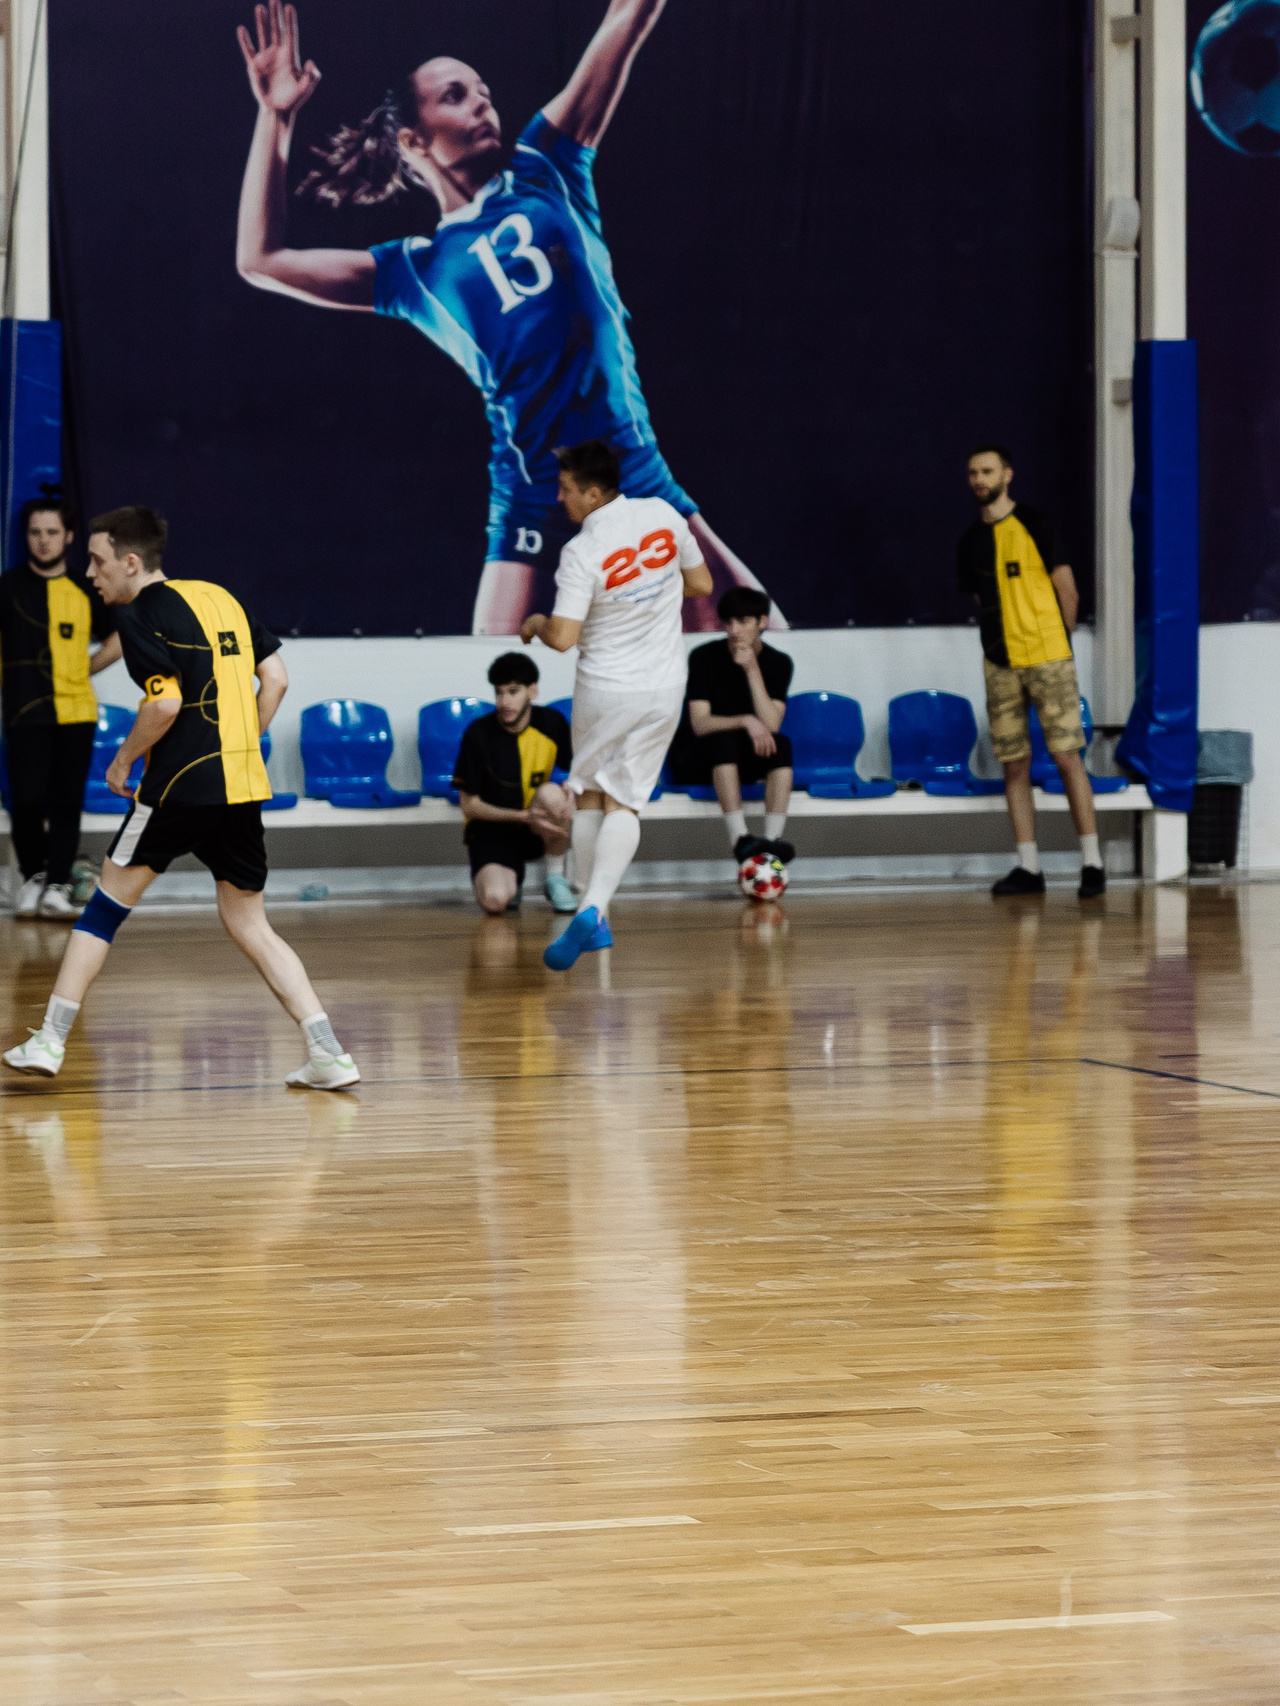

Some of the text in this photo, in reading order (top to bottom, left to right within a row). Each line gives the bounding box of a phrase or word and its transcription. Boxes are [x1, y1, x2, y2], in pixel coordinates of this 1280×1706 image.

[467, 213, 553, 314] 13
[602, 528, 677, 591] 23
[150, 678, 164, 696] C
